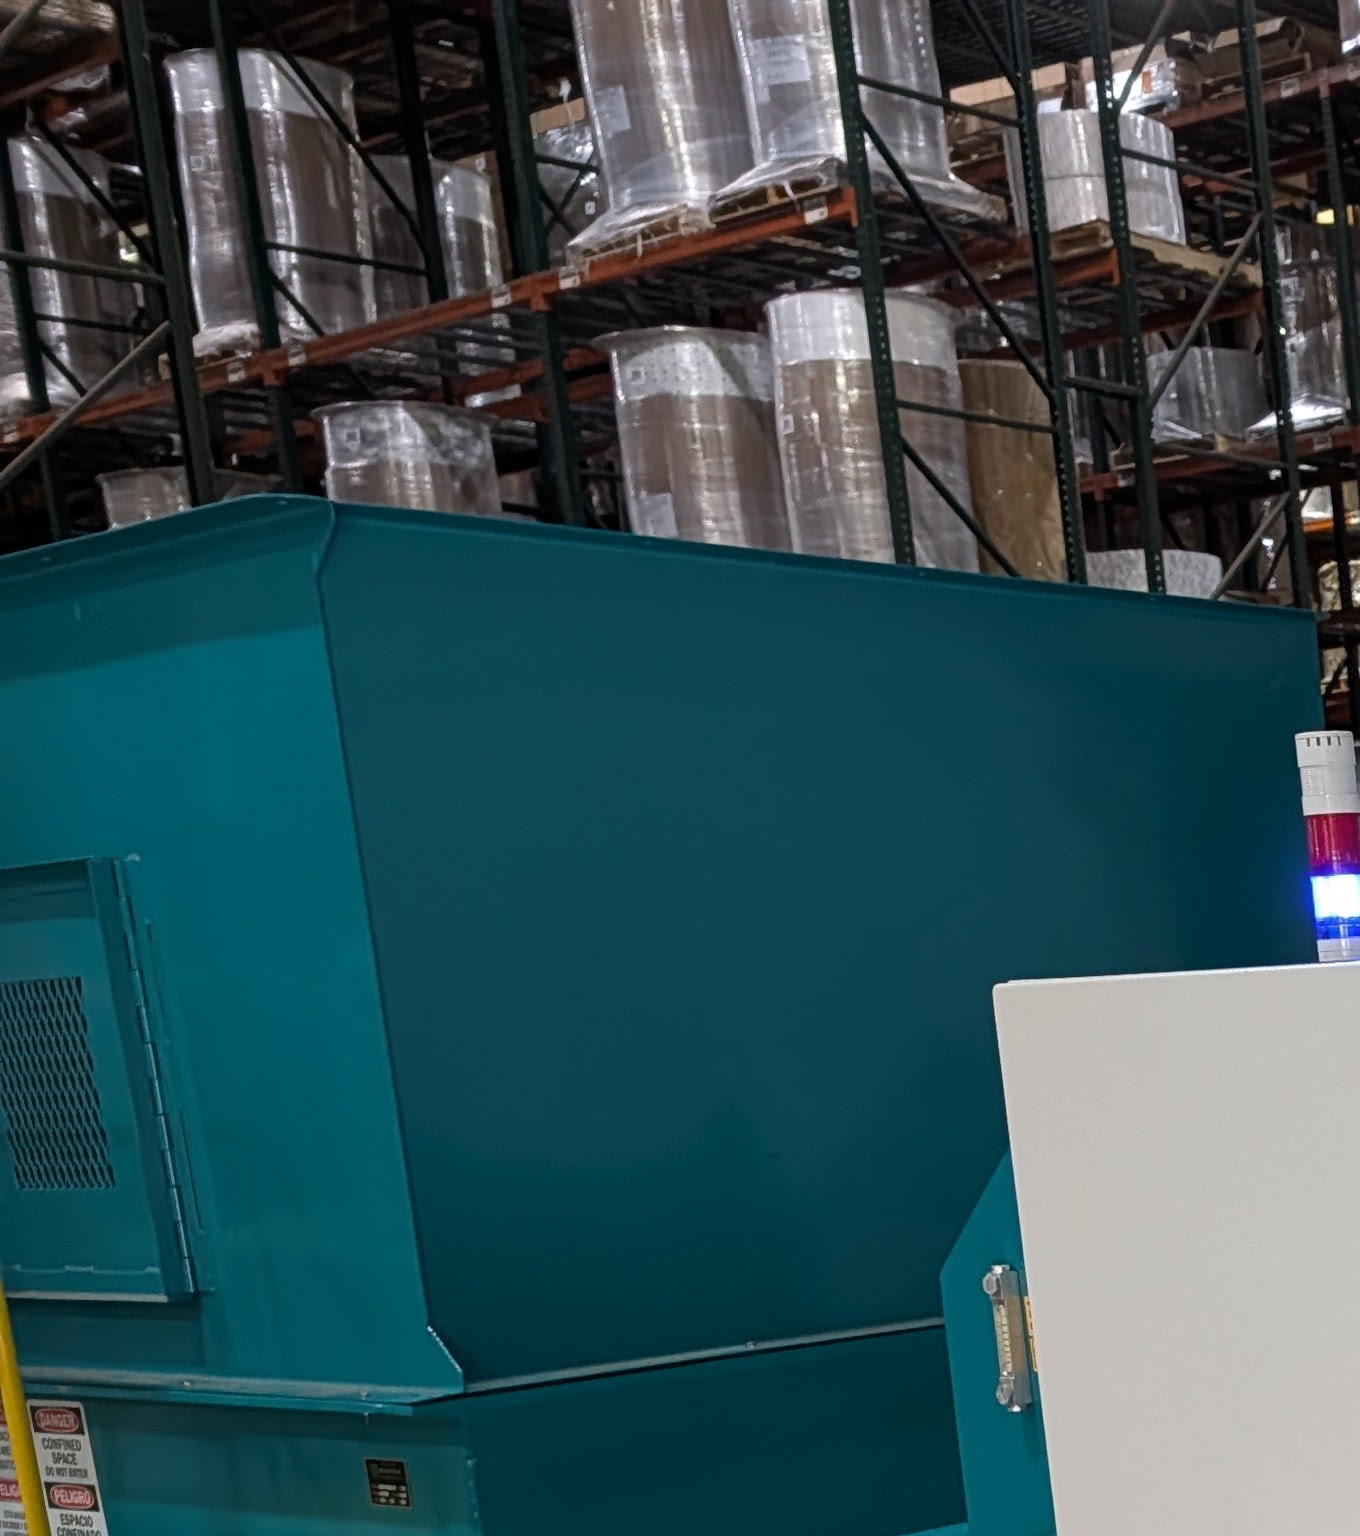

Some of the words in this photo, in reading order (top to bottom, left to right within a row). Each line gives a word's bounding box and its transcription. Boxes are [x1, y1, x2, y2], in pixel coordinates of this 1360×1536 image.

[42, 1437, 82, 1451] CONFINED
[52, 1452, 78, 1466] SPACE
[53, 1489, 91, 1505] PELIGRO
[60, 1514, 93, 1528] ESPACIO
